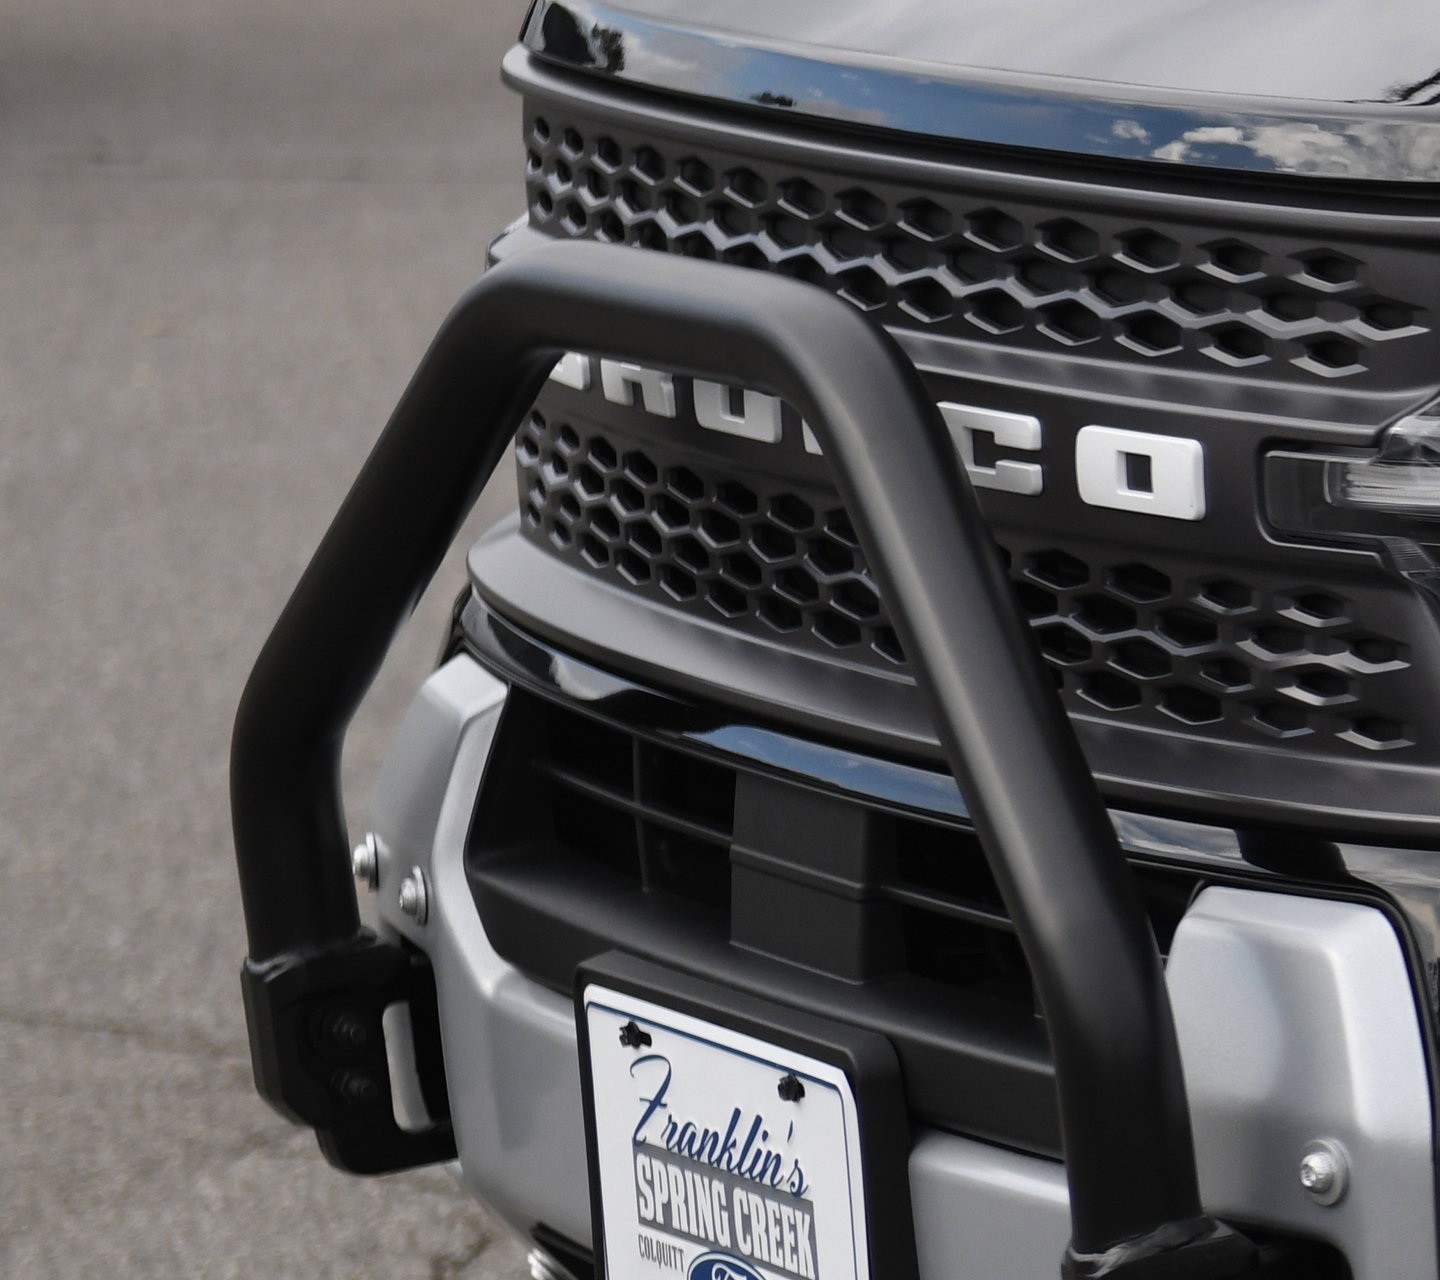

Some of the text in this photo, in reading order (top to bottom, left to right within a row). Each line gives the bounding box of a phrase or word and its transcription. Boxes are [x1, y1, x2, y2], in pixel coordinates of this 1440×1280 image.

[629, 1053, 810, 1199] Franklin's
[636, 1152, 818, 1280] SPRING CREEK
[637, 1233, 685, 1273] COLQUITT
